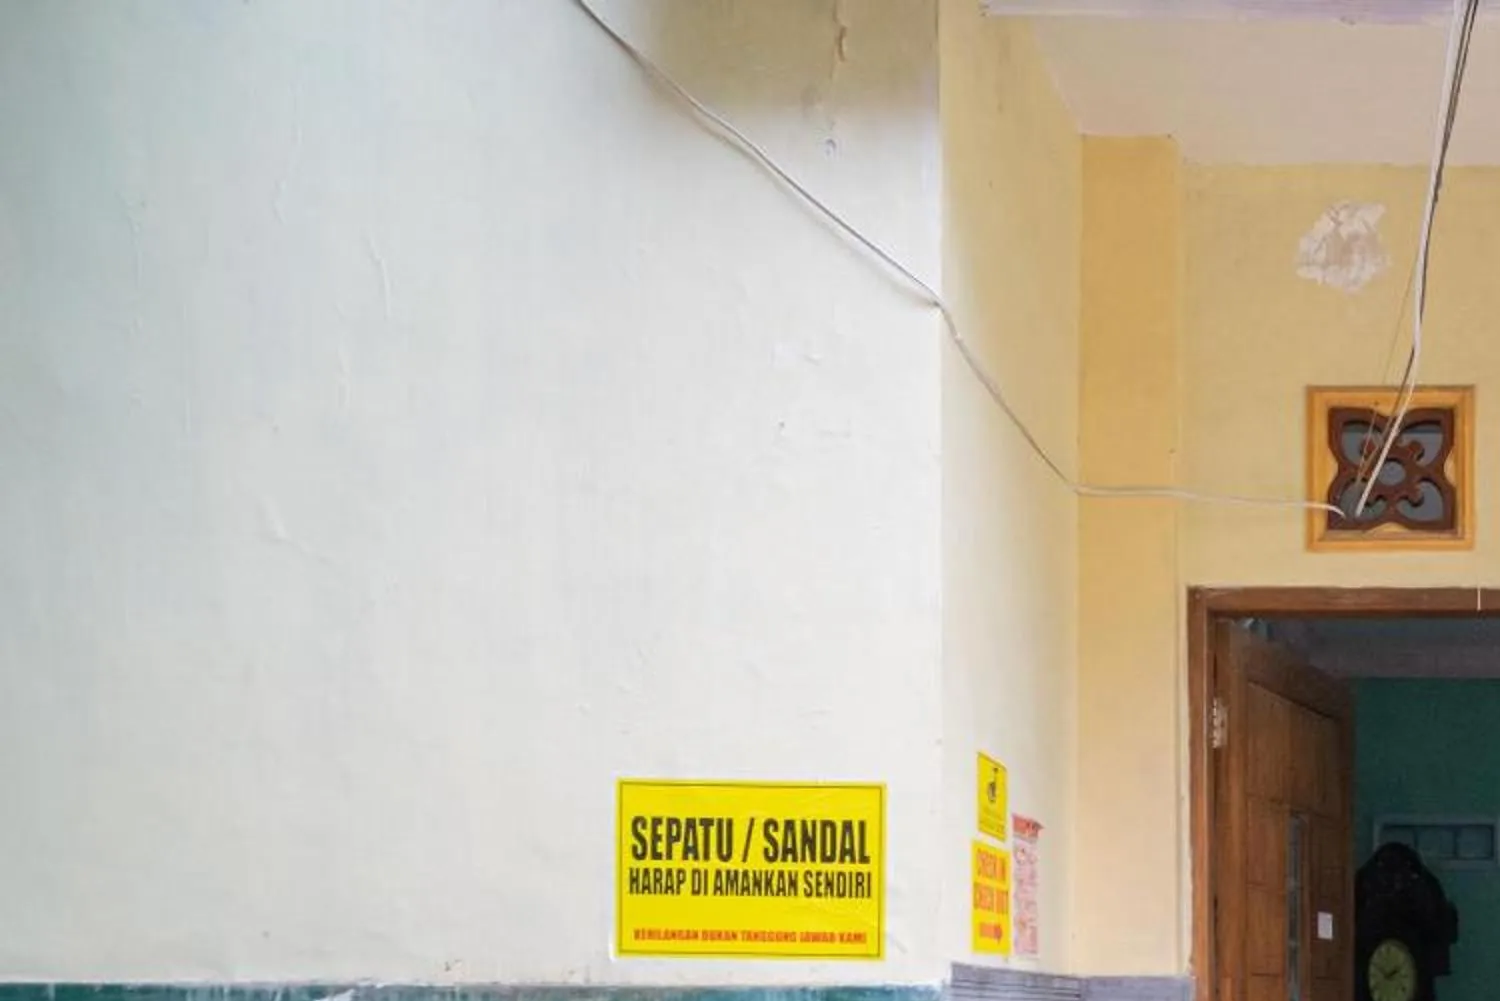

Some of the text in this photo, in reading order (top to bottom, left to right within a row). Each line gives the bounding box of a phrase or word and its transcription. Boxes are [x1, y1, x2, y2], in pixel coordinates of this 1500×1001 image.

[631, 816, 871, 865] SEPATU / SANDAL
[629, 867, 872, 899] HARAP DI AMANKAN SENDIRI
